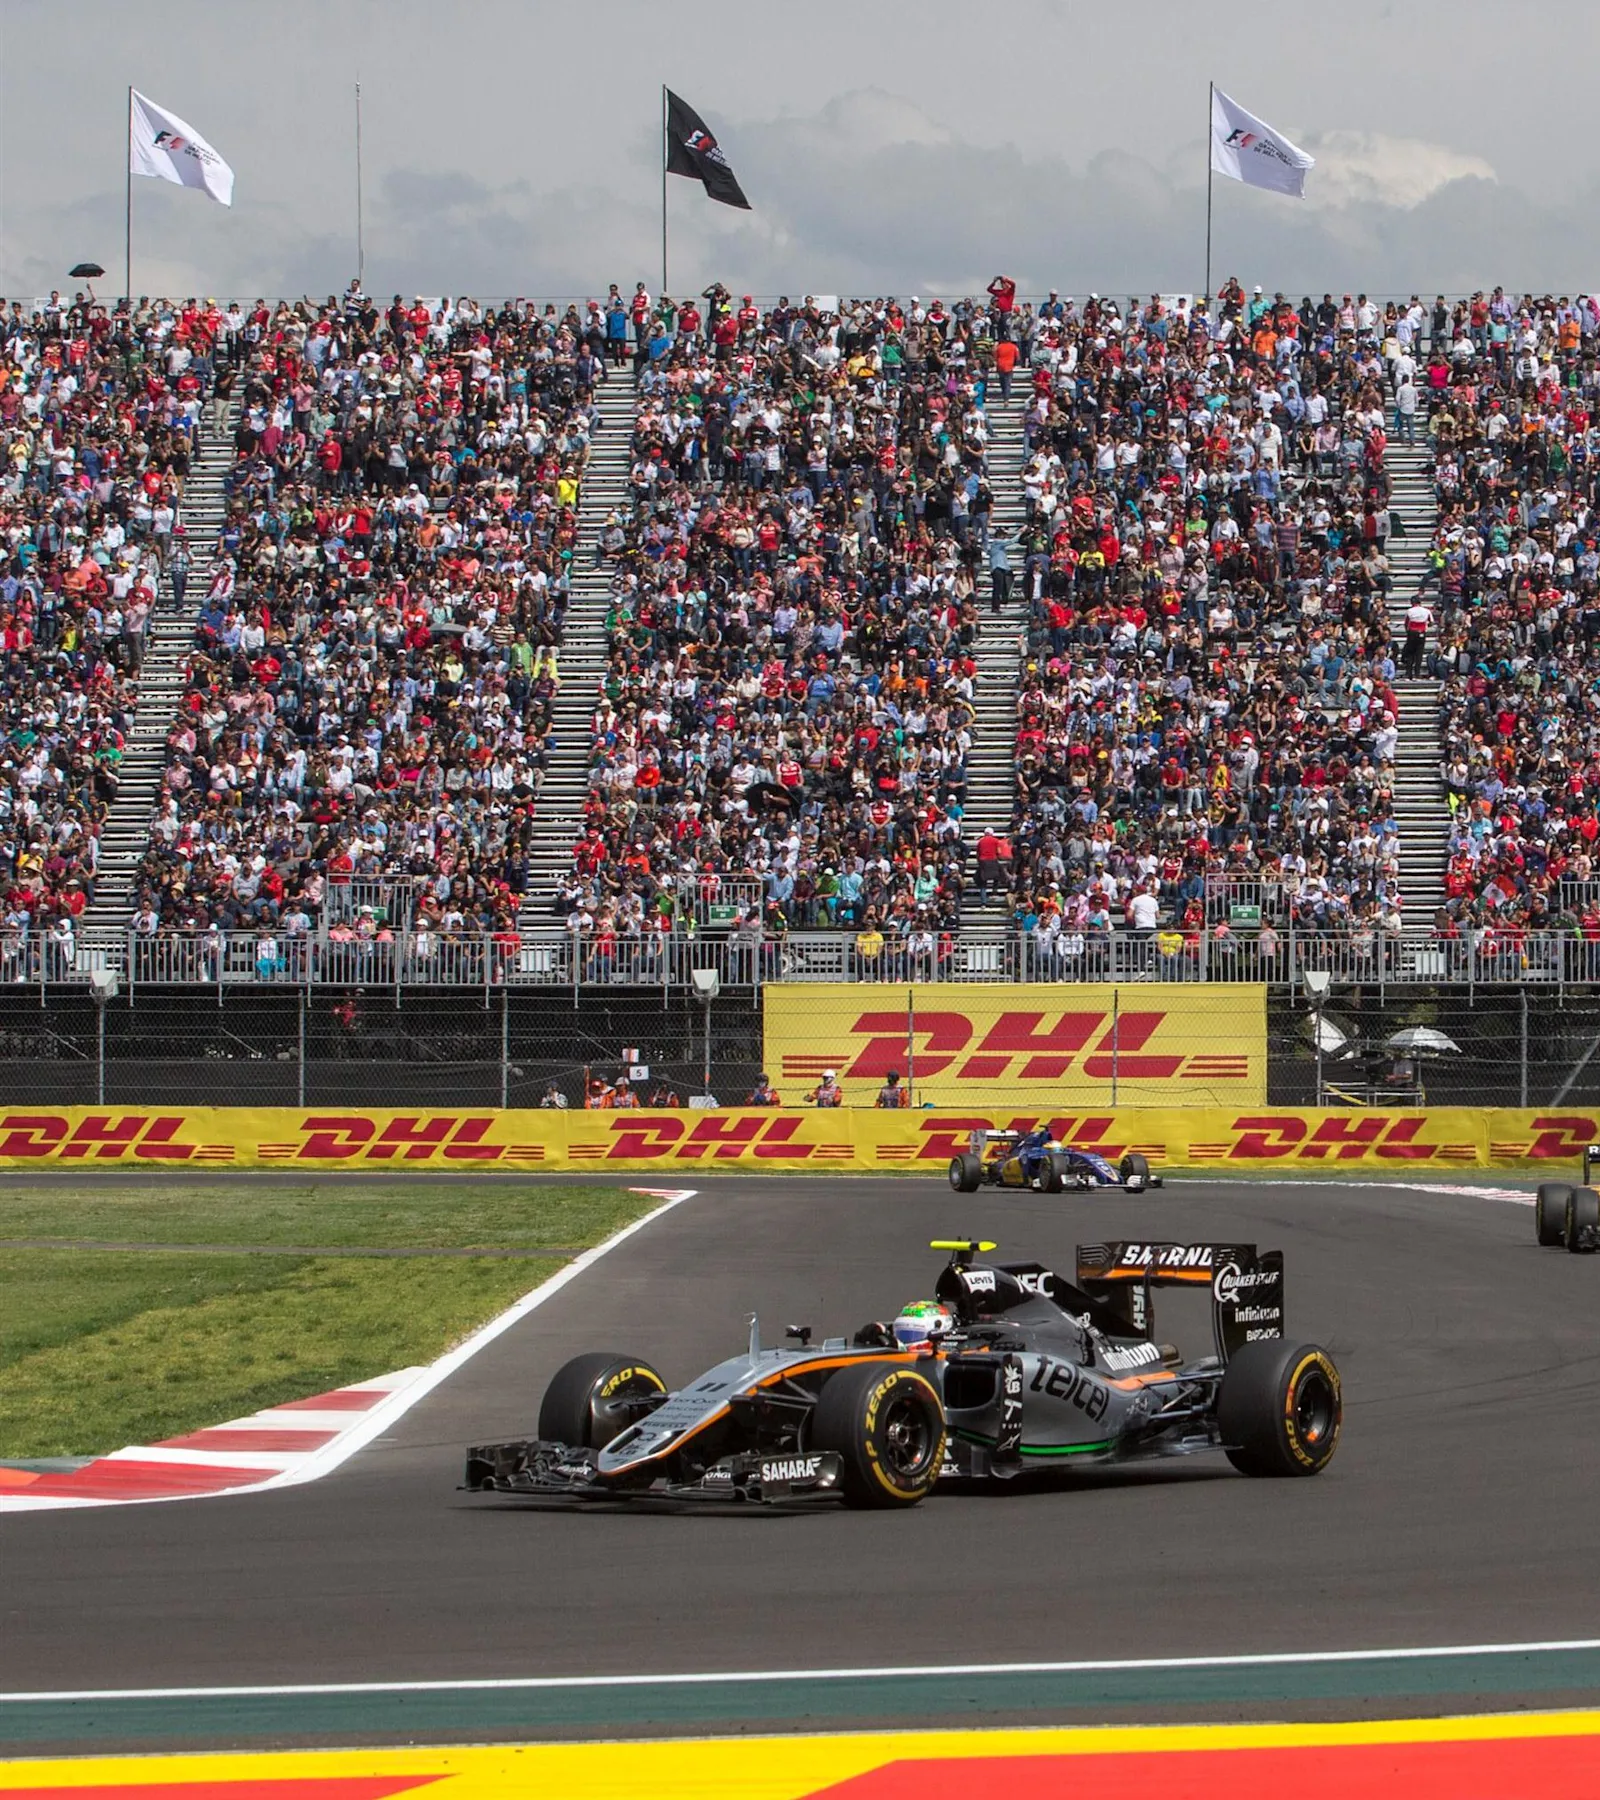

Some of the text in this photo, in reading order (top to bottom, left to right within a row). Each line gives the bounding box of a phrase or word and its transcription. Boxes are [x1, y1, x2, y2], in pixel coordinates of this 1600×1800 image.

[845, 1011, 1187, 1079] DHL
[0, 1116, 197, 1160] DHL
[299, 1117, 506, 1160] DHL
[608, 1117, 816, 1159] DHL
[916, 1117, 1128, 1159] DHL
[1229, 1117, 1437, 1159] DHL
[1122, 1245, 1213, 1265] SMIRNO
[1013, 1271, 1054, 1298] NEC
[600, 1367, 633, 1397] ERO
[1030, 1356, 1110, 1423] telcel
[865, 1373, 898, 1434] ZERO
[762, 1459, 816, 1482] SAHARA
